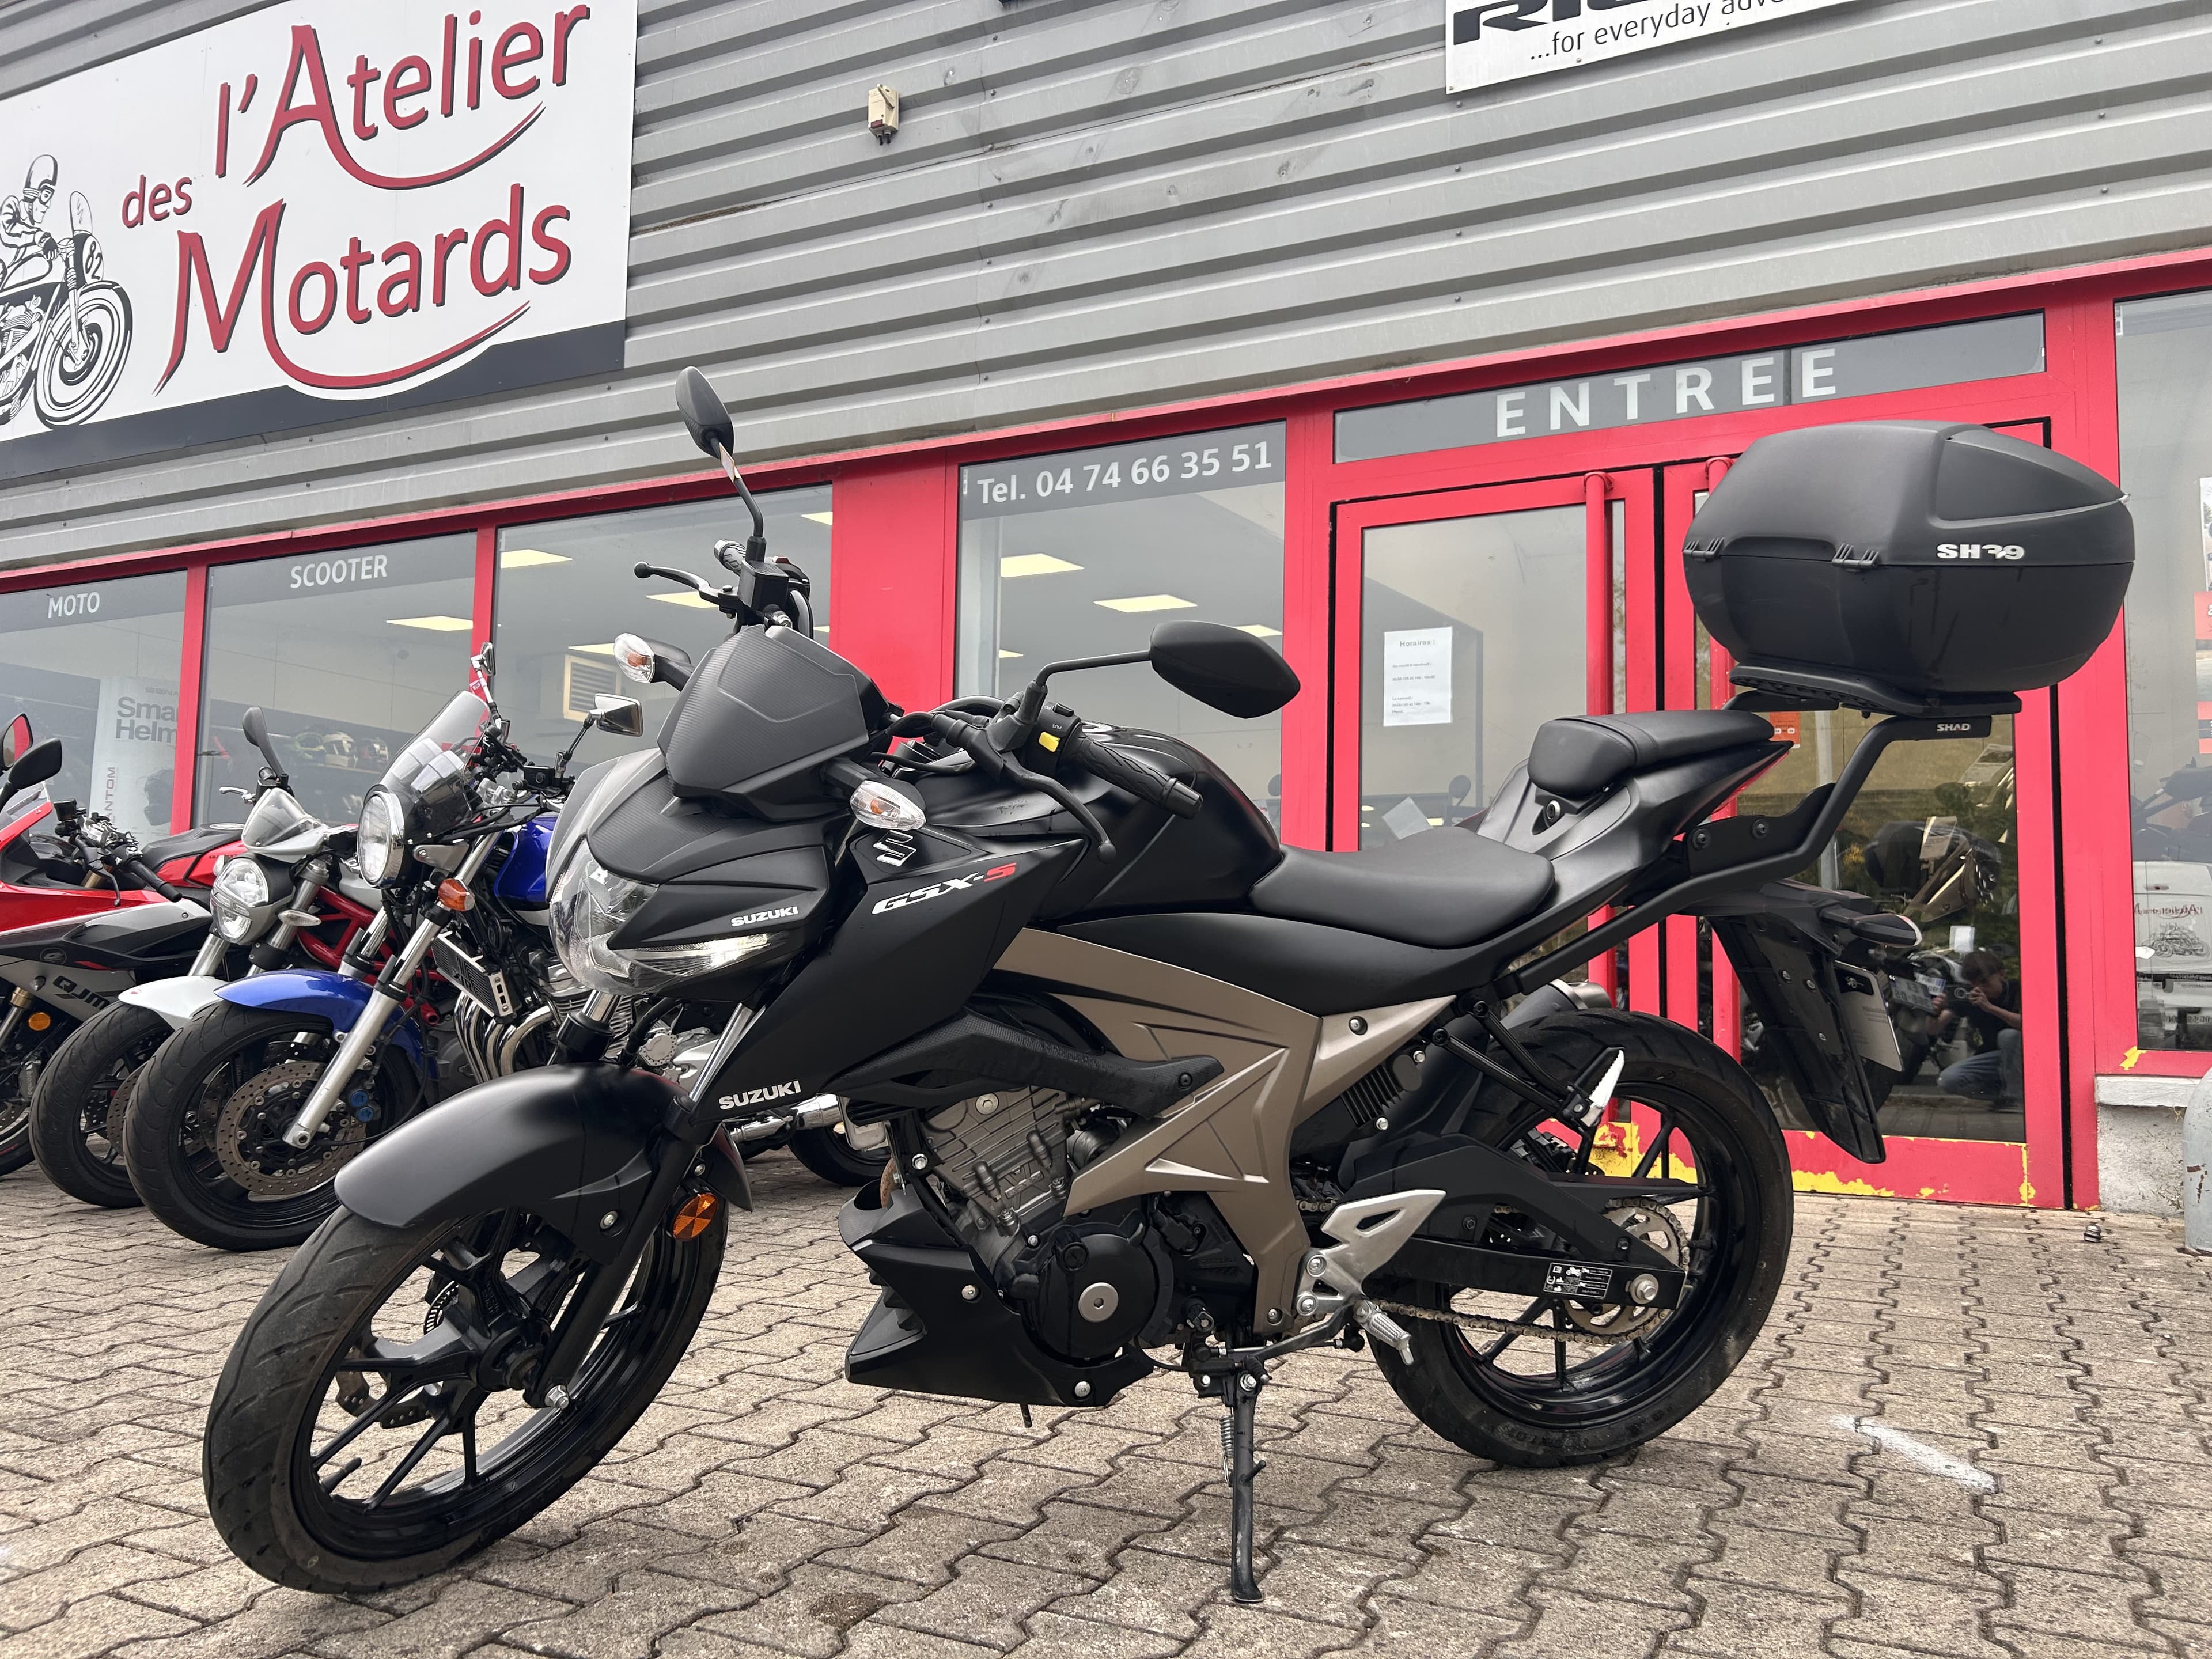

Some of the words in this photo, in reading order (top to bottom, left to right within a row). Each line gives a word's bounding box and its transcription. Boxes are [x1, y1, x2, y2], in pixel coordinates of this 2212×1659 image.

[1593, 2, 1710, 46] everyday
[121, 174, 193, 229] des
[85, 240, 103, 281] 82
[151, 183, 571, 397] Motards
[1497, 348, 1836, 438] ENTREE
[977, 475, 1026, 504] Tel.
[1035, 468, 1074, 498] 04
[1082, 461, 1122, 491] 74
[1130, 454, 1170, 485] 66
[1179, 448, 1221, 479] 35
[1230, 441, 1272, 472] 51
[290, 554, 388, 589] SCOOTER
[47, 592, 100, 618] MOTO
[117, 696, 178, 721] Sma
[1936, 723, 1971, 732] SHAD
[872, 862, 1017, 915] GSX-S
[731, 906, 799, 927] SUZUKI
[719, 1080, 802, 1110] SUZUKI
